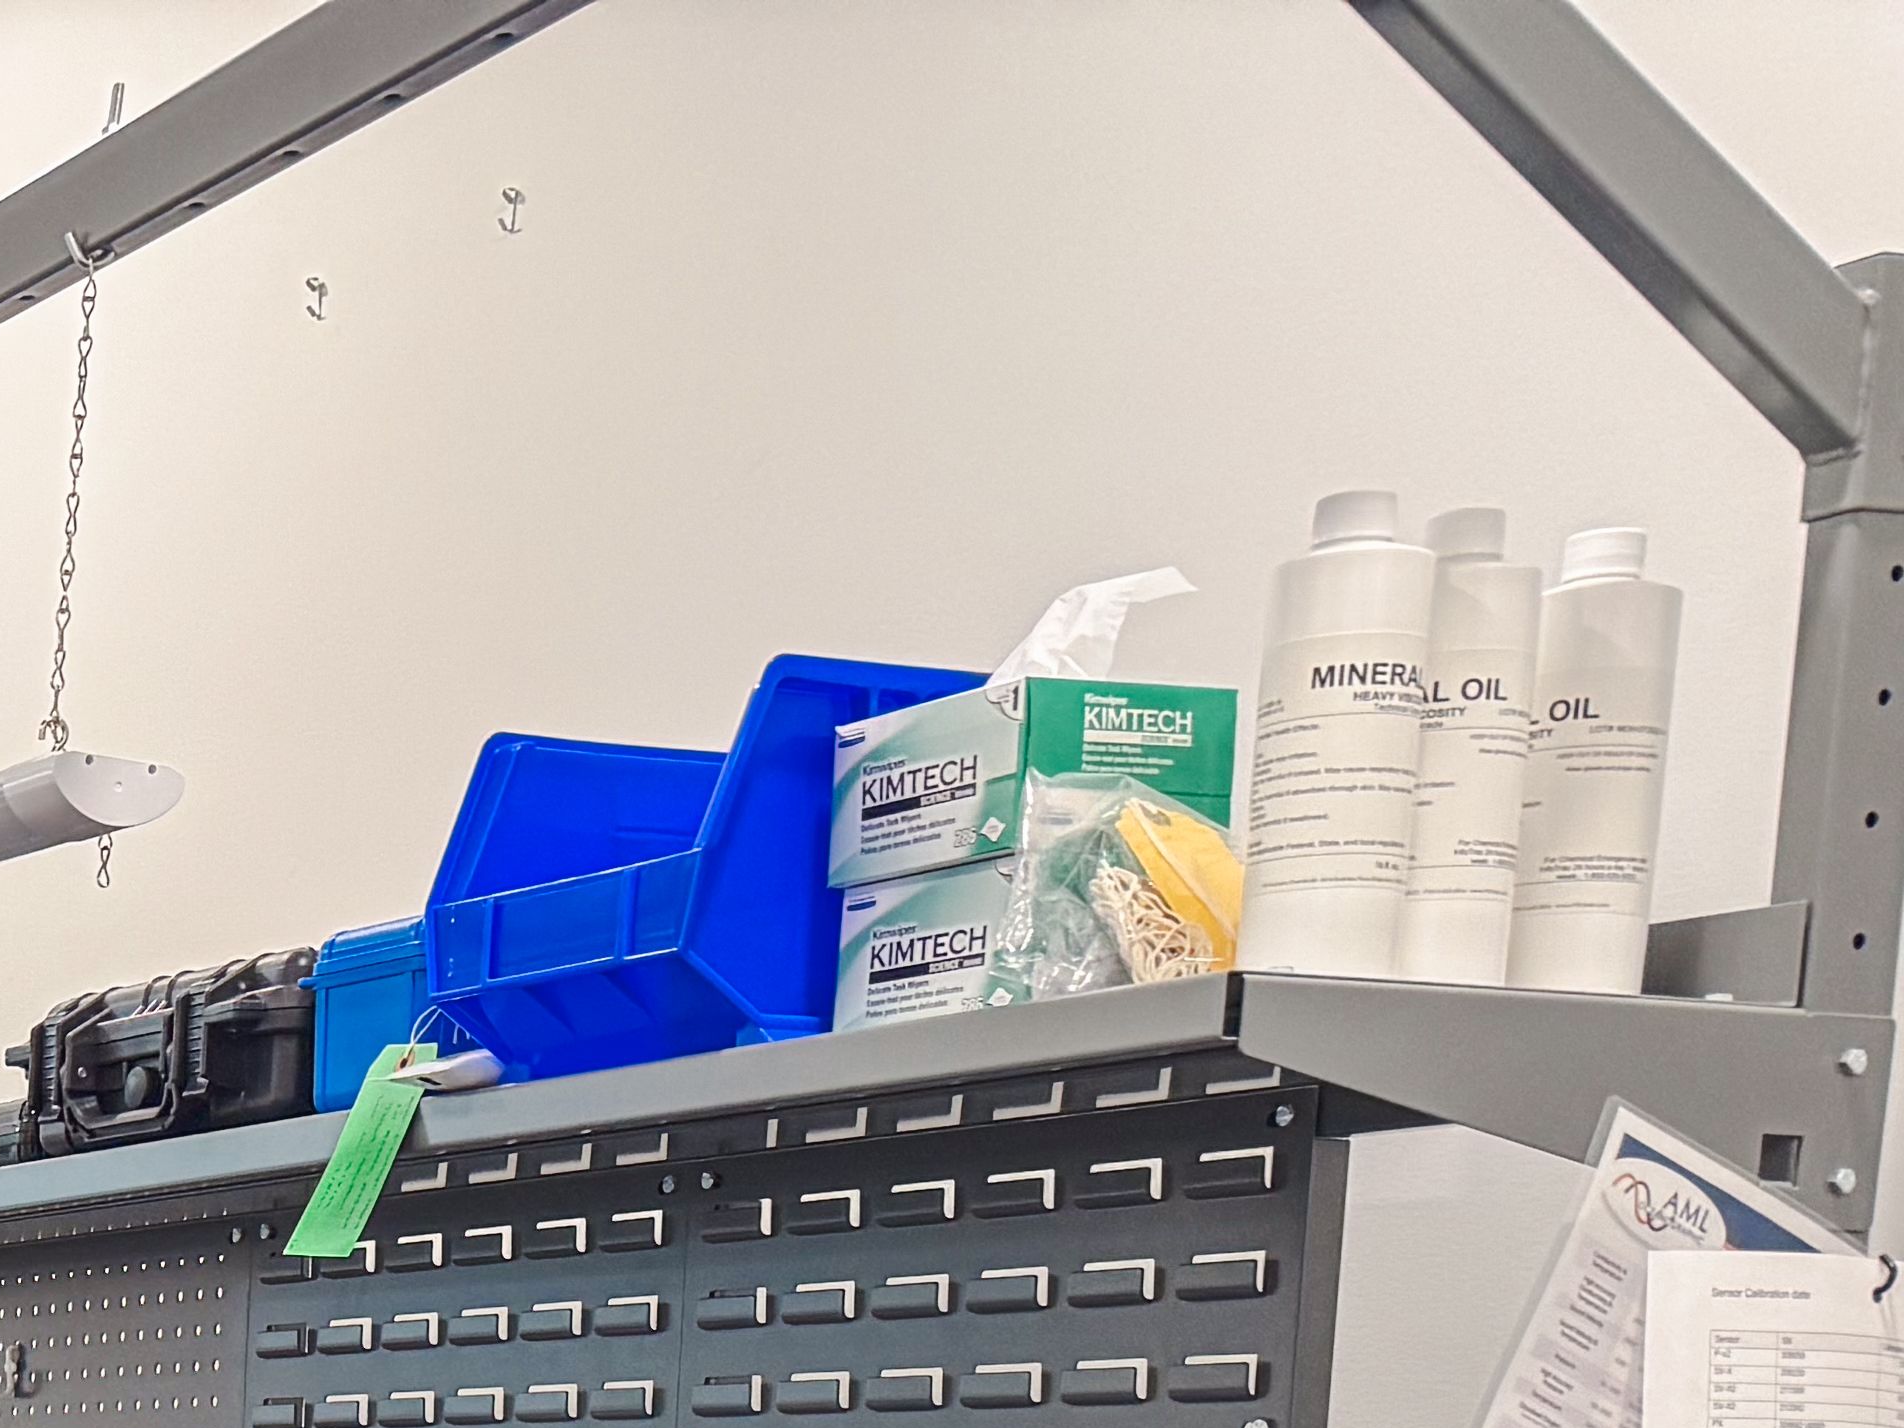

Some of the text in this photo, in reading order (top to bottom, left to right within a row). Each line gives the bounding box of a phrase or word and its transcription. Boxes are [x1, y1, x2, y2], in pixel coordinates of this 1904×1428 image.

[1311, 662, 1421, 689] MINERA
[1461, 678, 1508, 701] OIL
[1084, 706, 1192, 733] KIMTECH
[1549, 697, 1600, 721] OIL
[862, 755, 977, 806] KIMTECH
[870, 925, 987, 970] KIMTECH
[1658, 1192, 1710, 1235] AML
[1712, 1288, 1742, 1298] Sensor
[1744, 1288, 1790, 1299] Calibration
